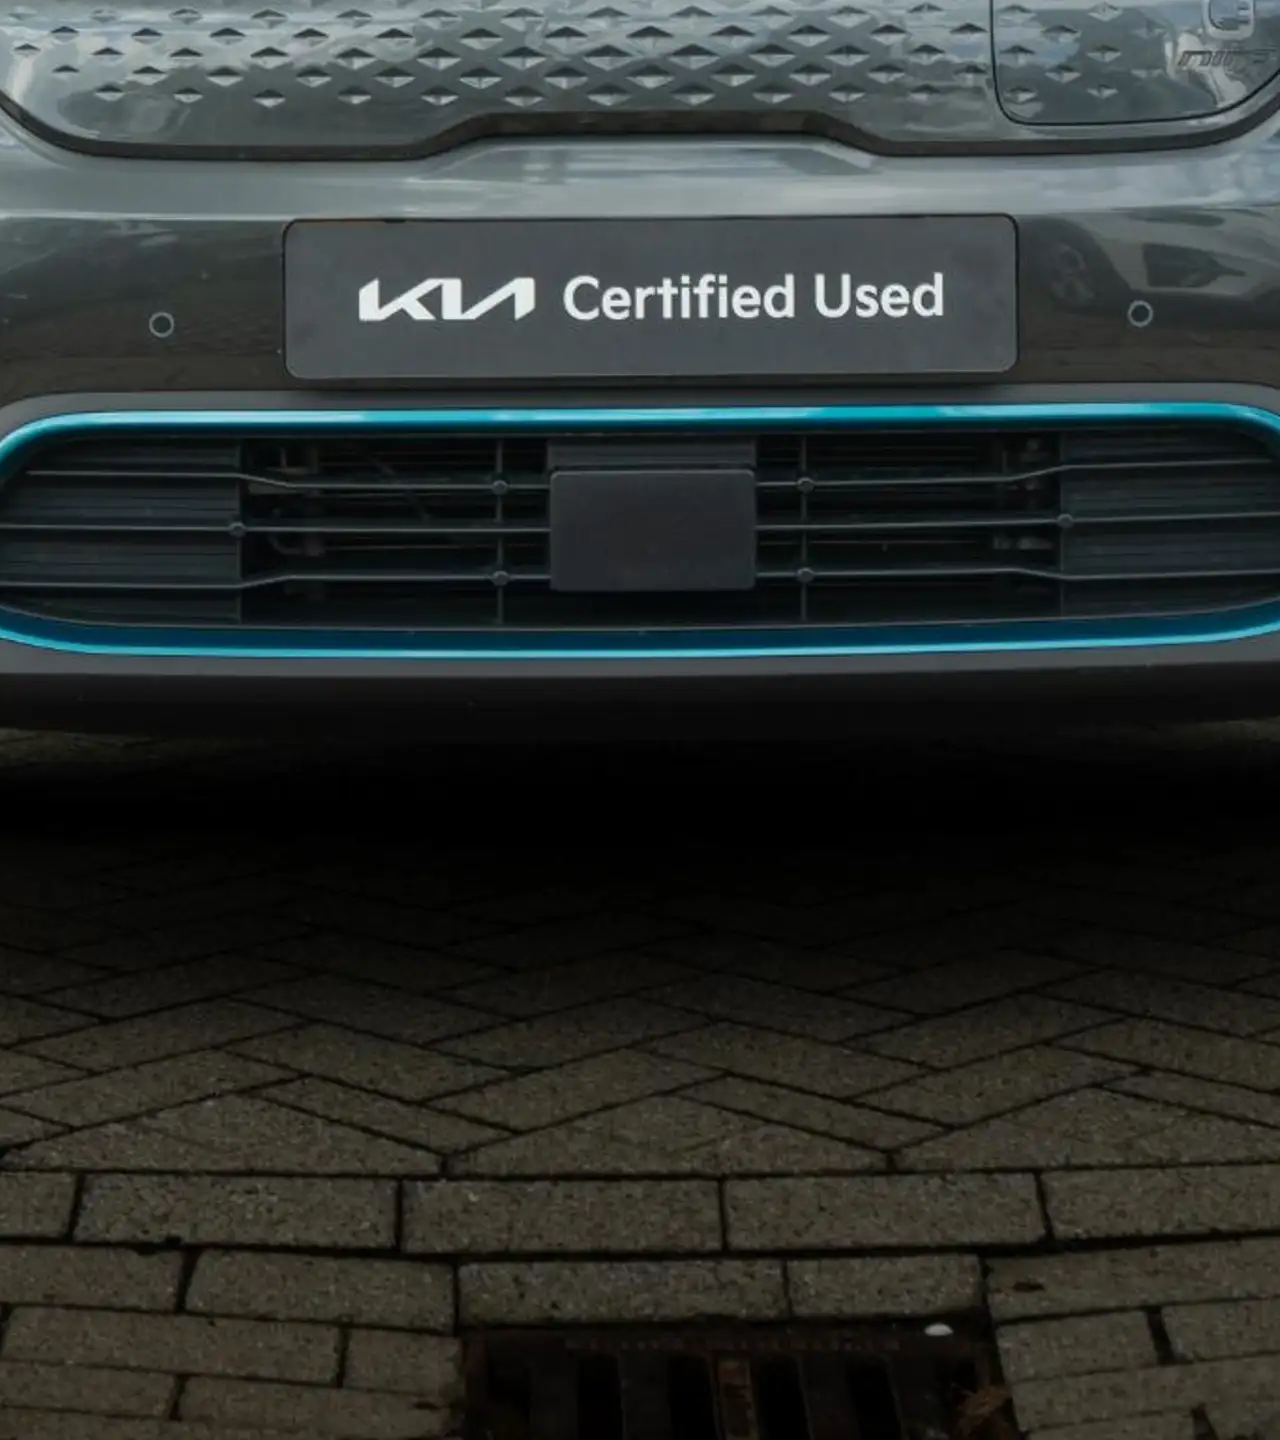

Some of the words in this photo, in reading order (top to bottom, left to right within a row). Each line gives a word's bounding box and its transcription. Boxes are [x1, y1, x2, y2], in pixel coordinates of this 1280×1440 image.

[358, 277, 536, 322] KIA
[563, 272, 795, 320] Certified
[815, 272, 944, 318] Used
